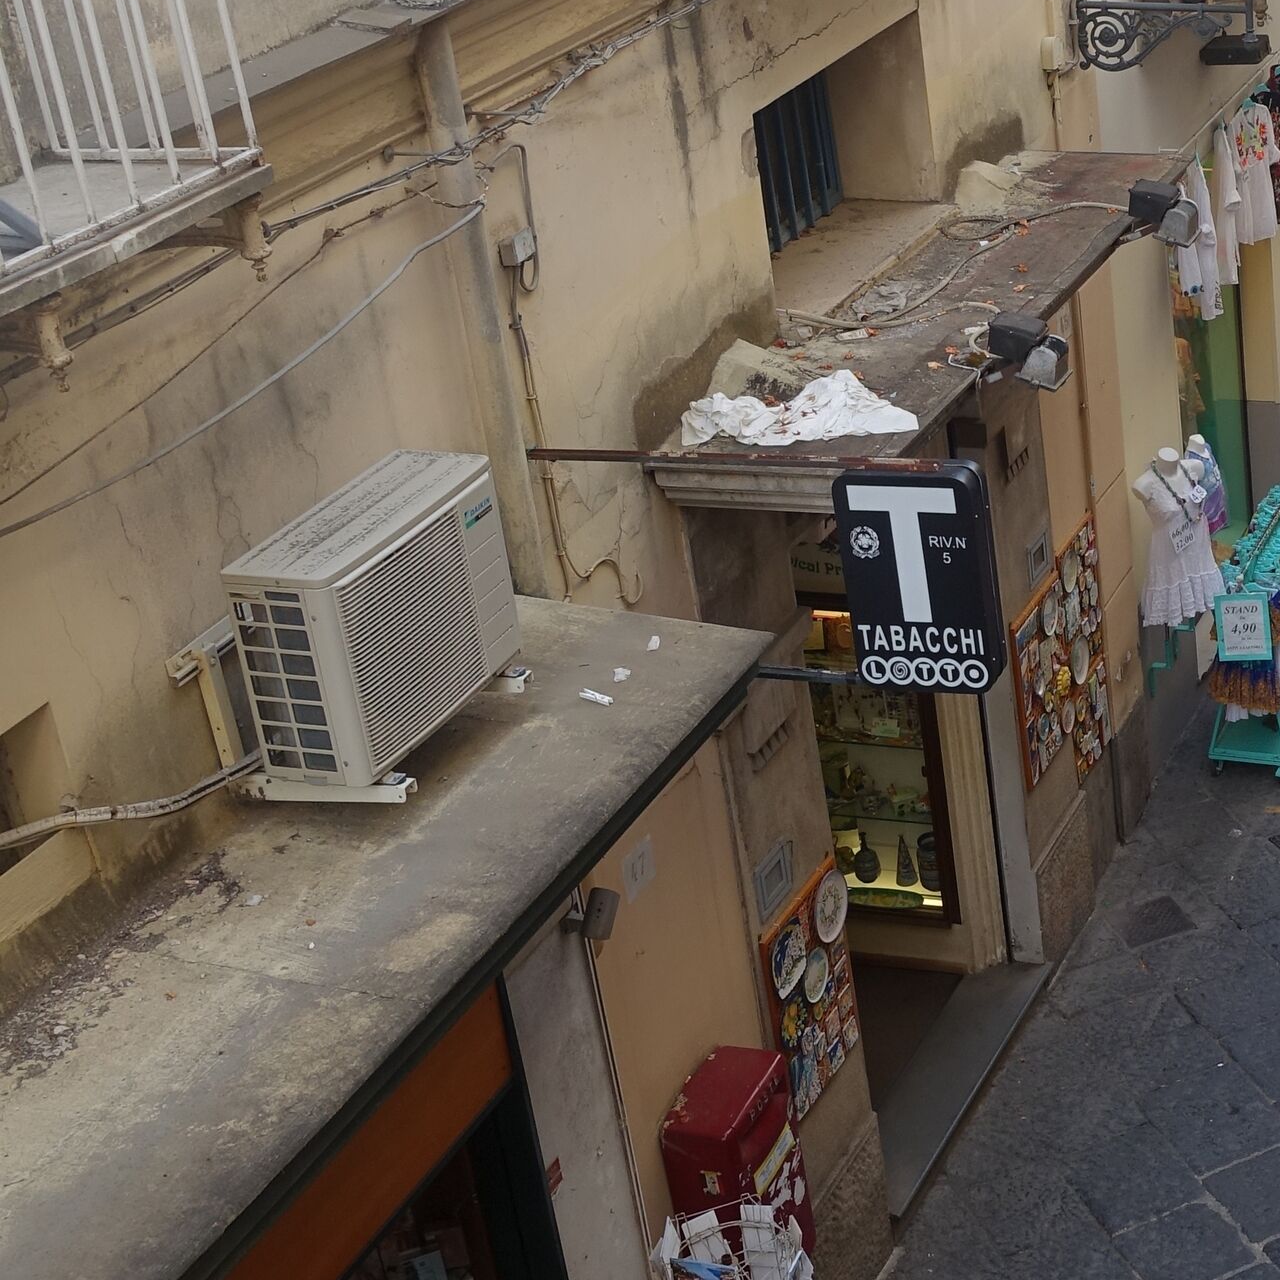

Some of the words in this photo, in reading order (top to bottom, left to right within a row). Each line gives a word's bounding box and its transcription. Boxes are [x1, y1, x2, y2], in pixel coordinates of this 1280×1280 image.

[942, 552, 951, 564] 5
[1224, 605, 1258, 615] STAND
[1231, 623, 1257, 635] 4,90
[857, 624, 985, 656] TABACCHI
